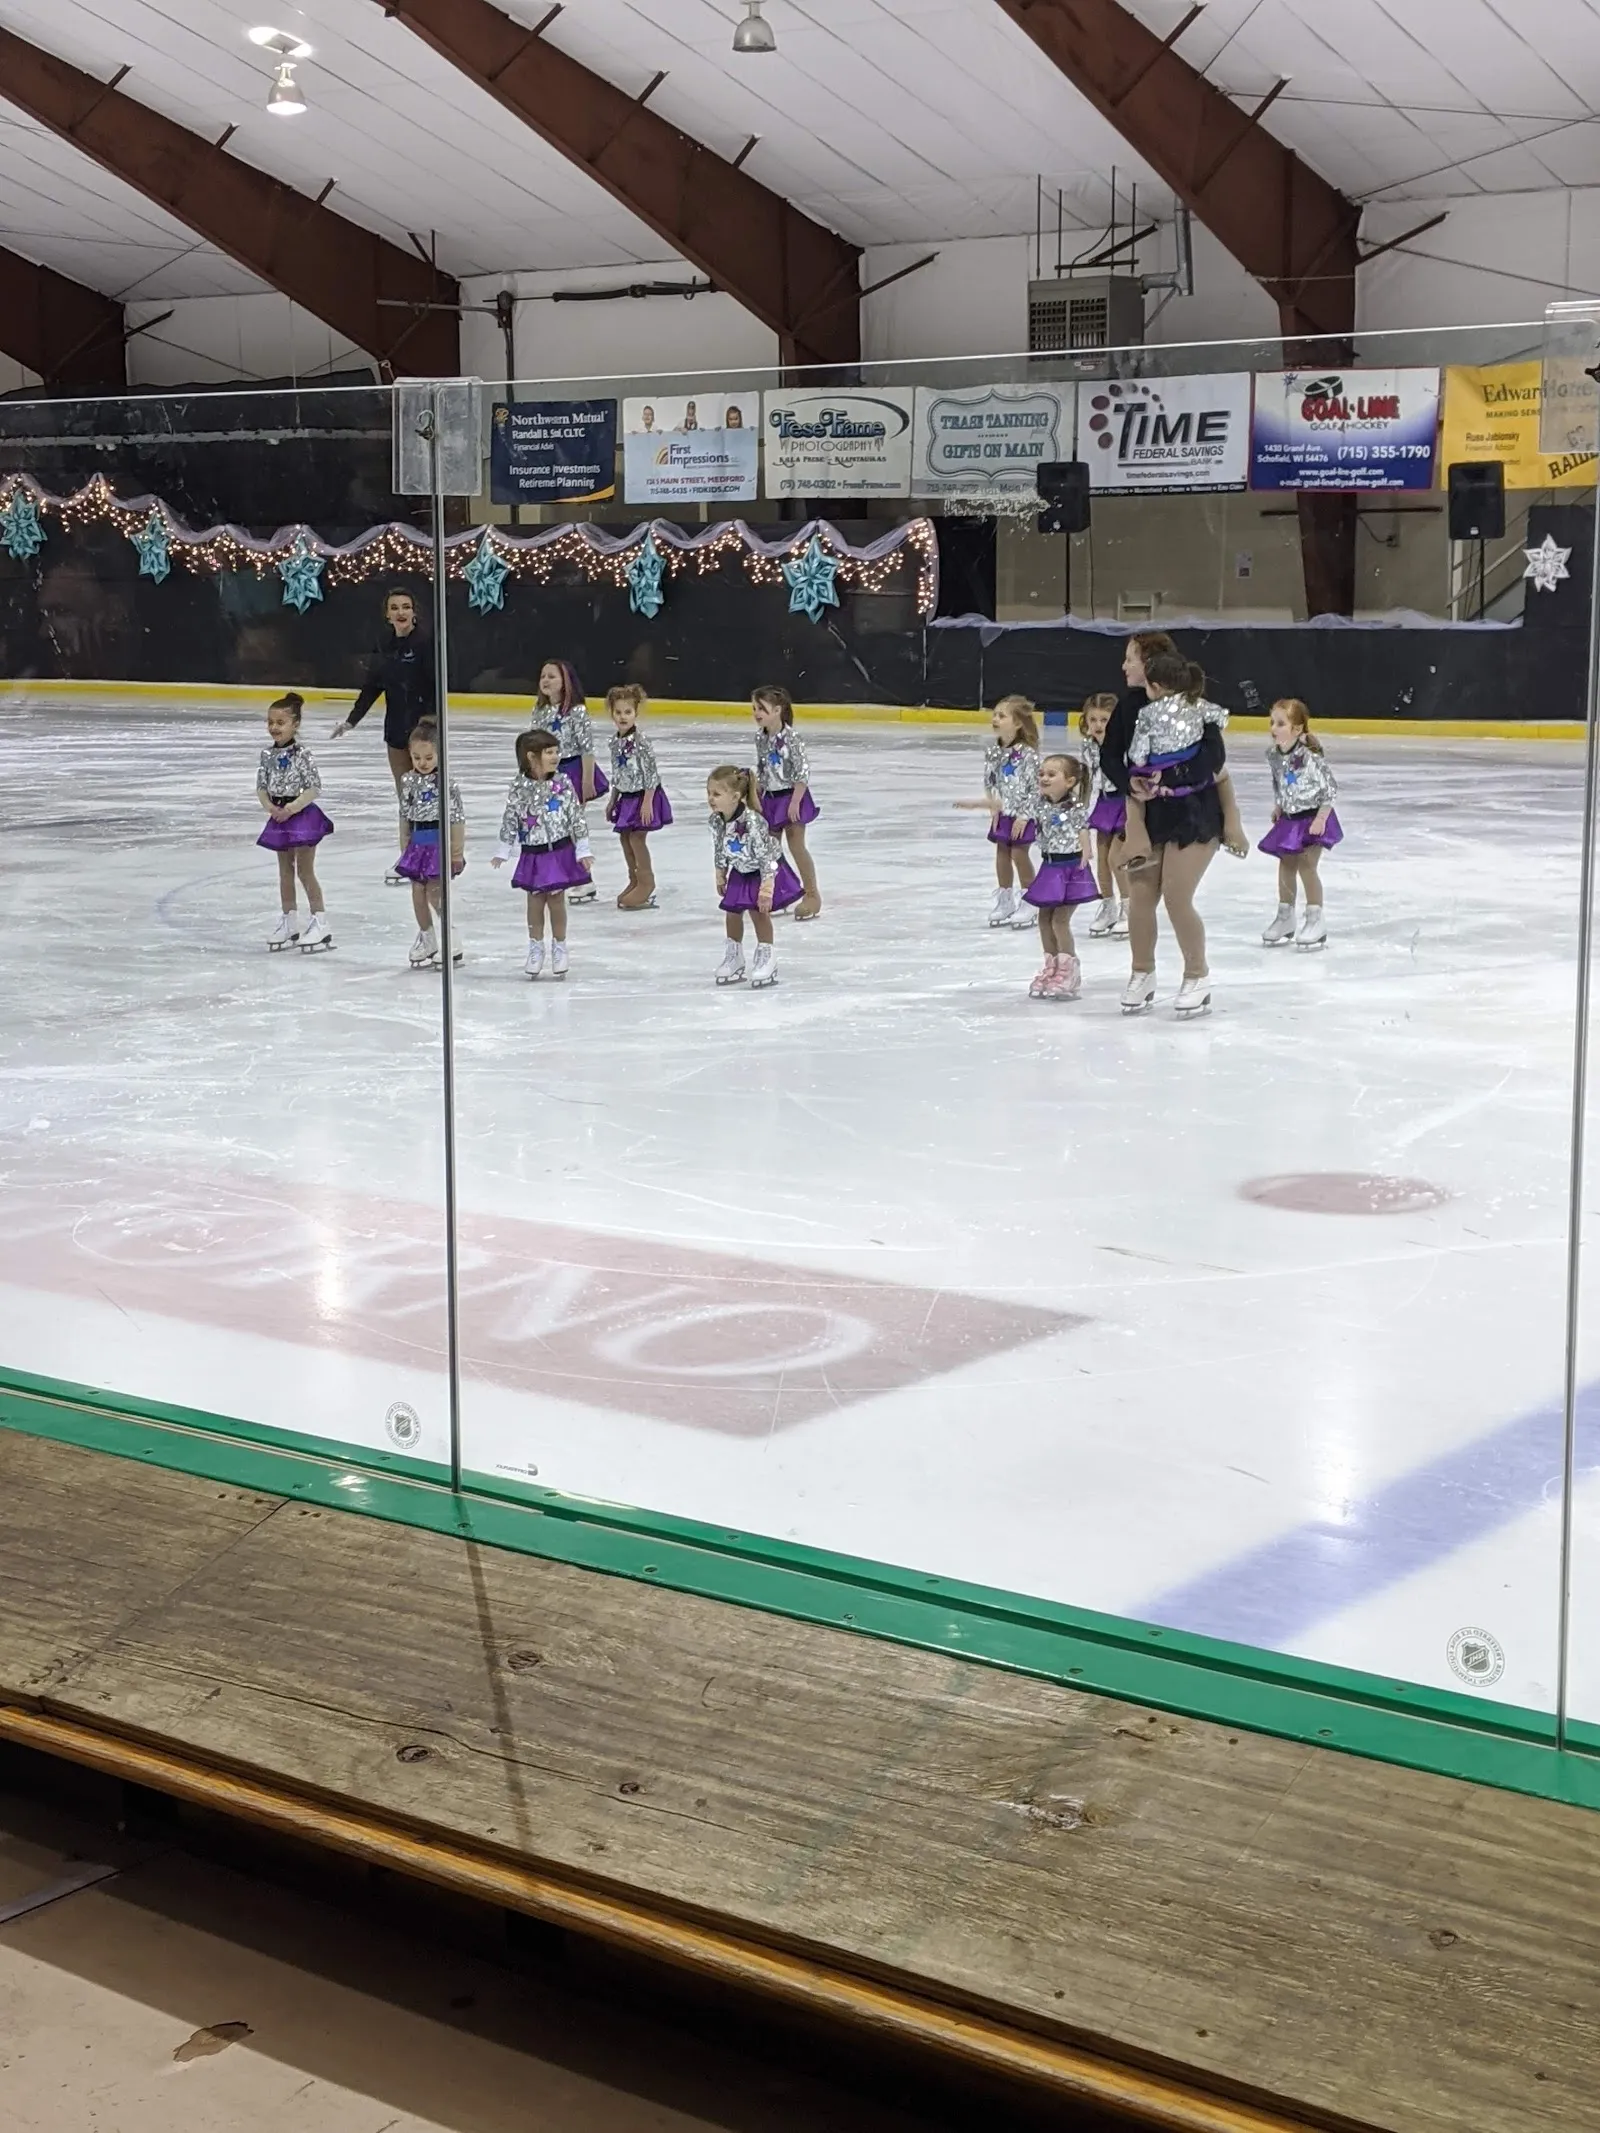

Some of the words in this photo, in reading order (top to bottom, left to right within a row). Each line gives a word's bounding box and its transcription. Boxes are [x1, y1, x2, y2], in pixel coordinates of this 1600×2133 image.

[986, 412, 1049, 428] TANNING
[1310, 422, 1338, 431] GOLF
[1345, 420, 1390, 430] HOCKEY
[1113, 402, 1231, 459] TIME
[670, 444, 691, 455] First
[791, 440, 872, 452] PHOTOGRAPHY
[943, 444, 981, 459] GIFTS
[983, 443, 1002, 458] ON
[1005, 442, 1045, 458] MAIN
[1133, 448, 1179, 459] FEDERAL
[1181, 446, 1224, 458] SAVINGS
[1292, 454, 1304, 463] WI
[1305, 454, 1329, 463] 54476
[1337, 447, 1368, 460] (715)
[1371, 445, 1431, 459] 355-1790
[669, 452, 730, 469] Impressions
[509, 465, 551, 475] Insurance
[1126, 470, 1210, 480] timefederalsavings.com
[556, 476, 595, 490] Planning
[707, 475, 746, 483] MEDFORD
